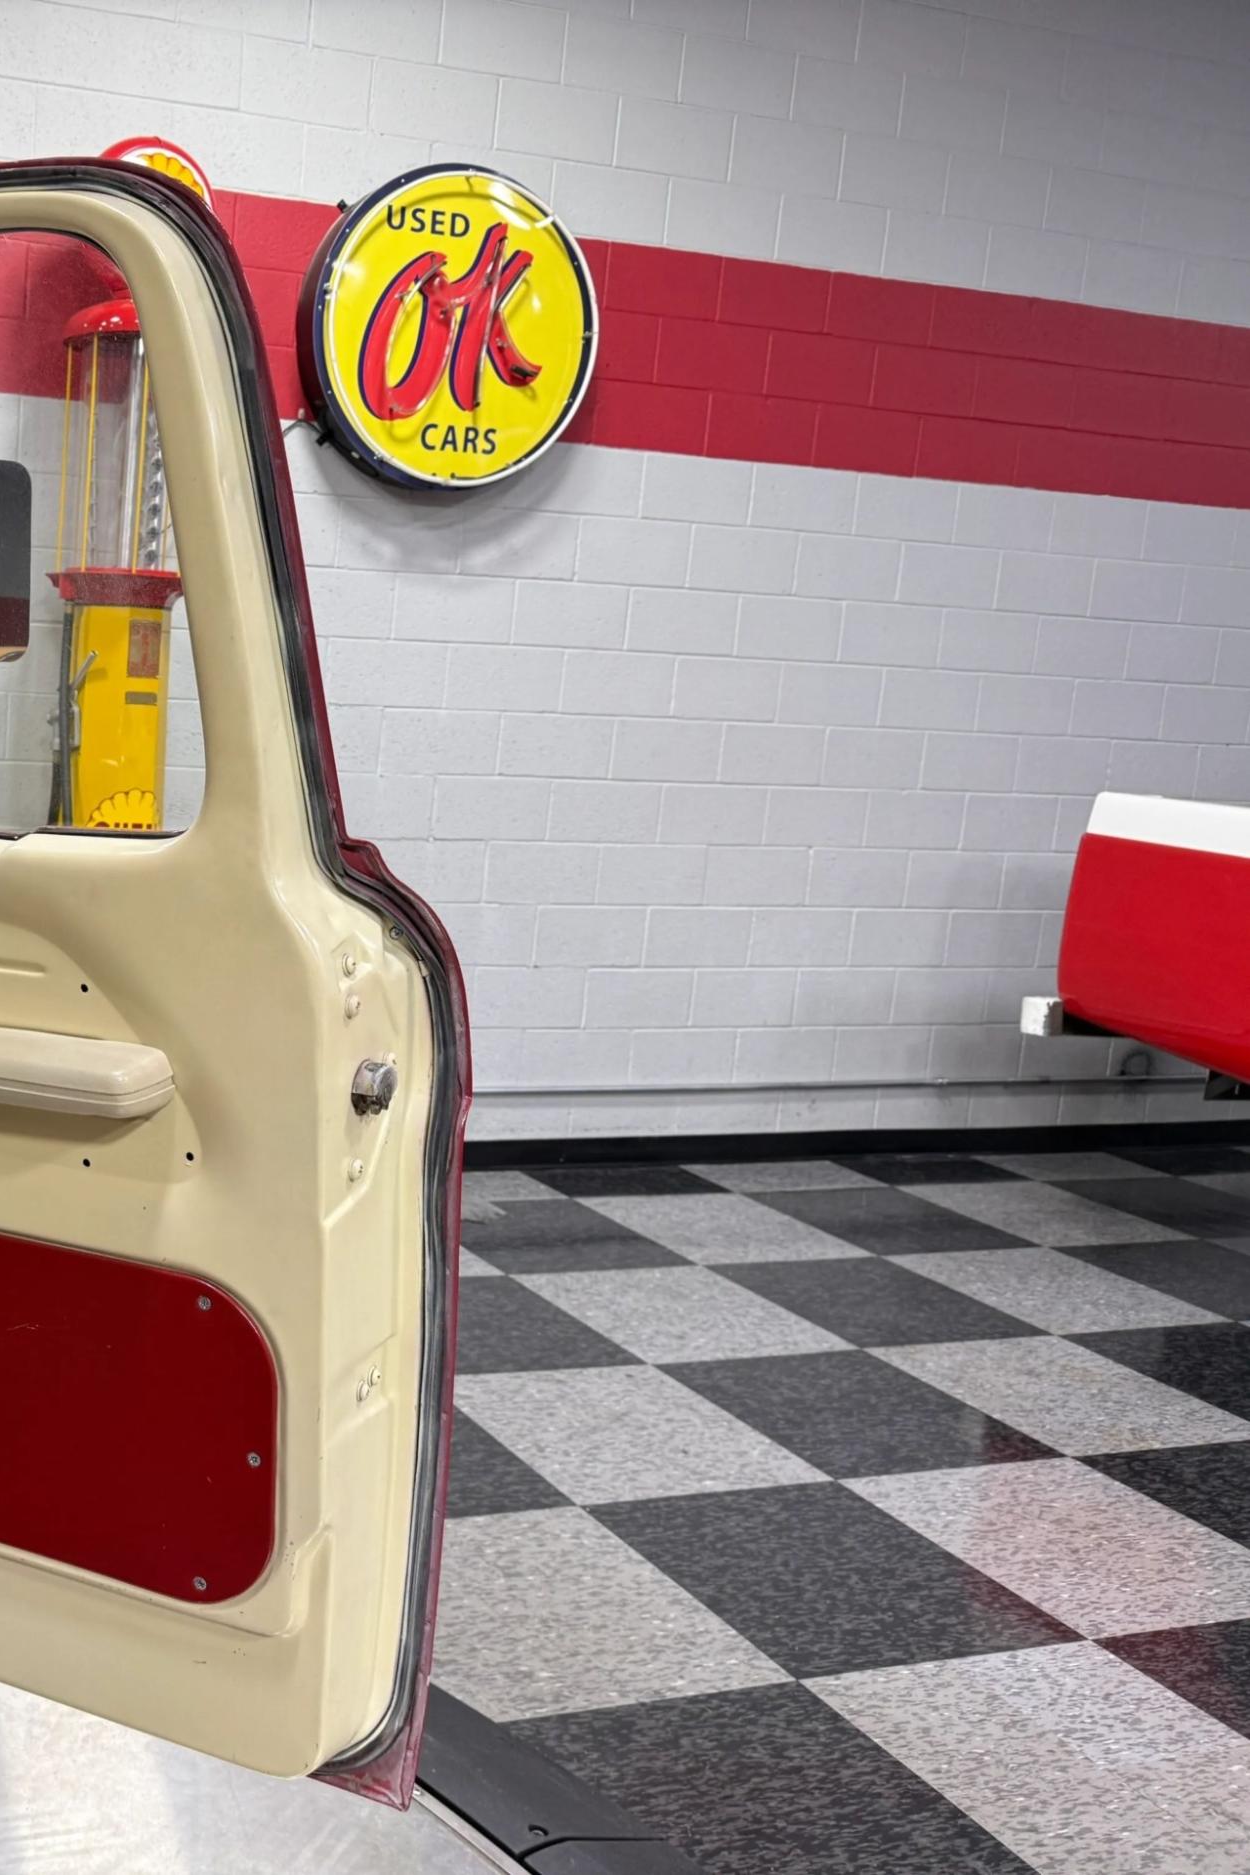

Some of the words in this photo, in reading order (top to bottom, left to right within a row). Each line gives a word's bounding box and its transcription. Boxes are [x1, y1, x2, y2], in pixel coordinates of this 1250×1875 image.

[386, 204, 471, 238] USED
[357, 222, 543, 421] OK
[420, 423, 497, 455] CARS
